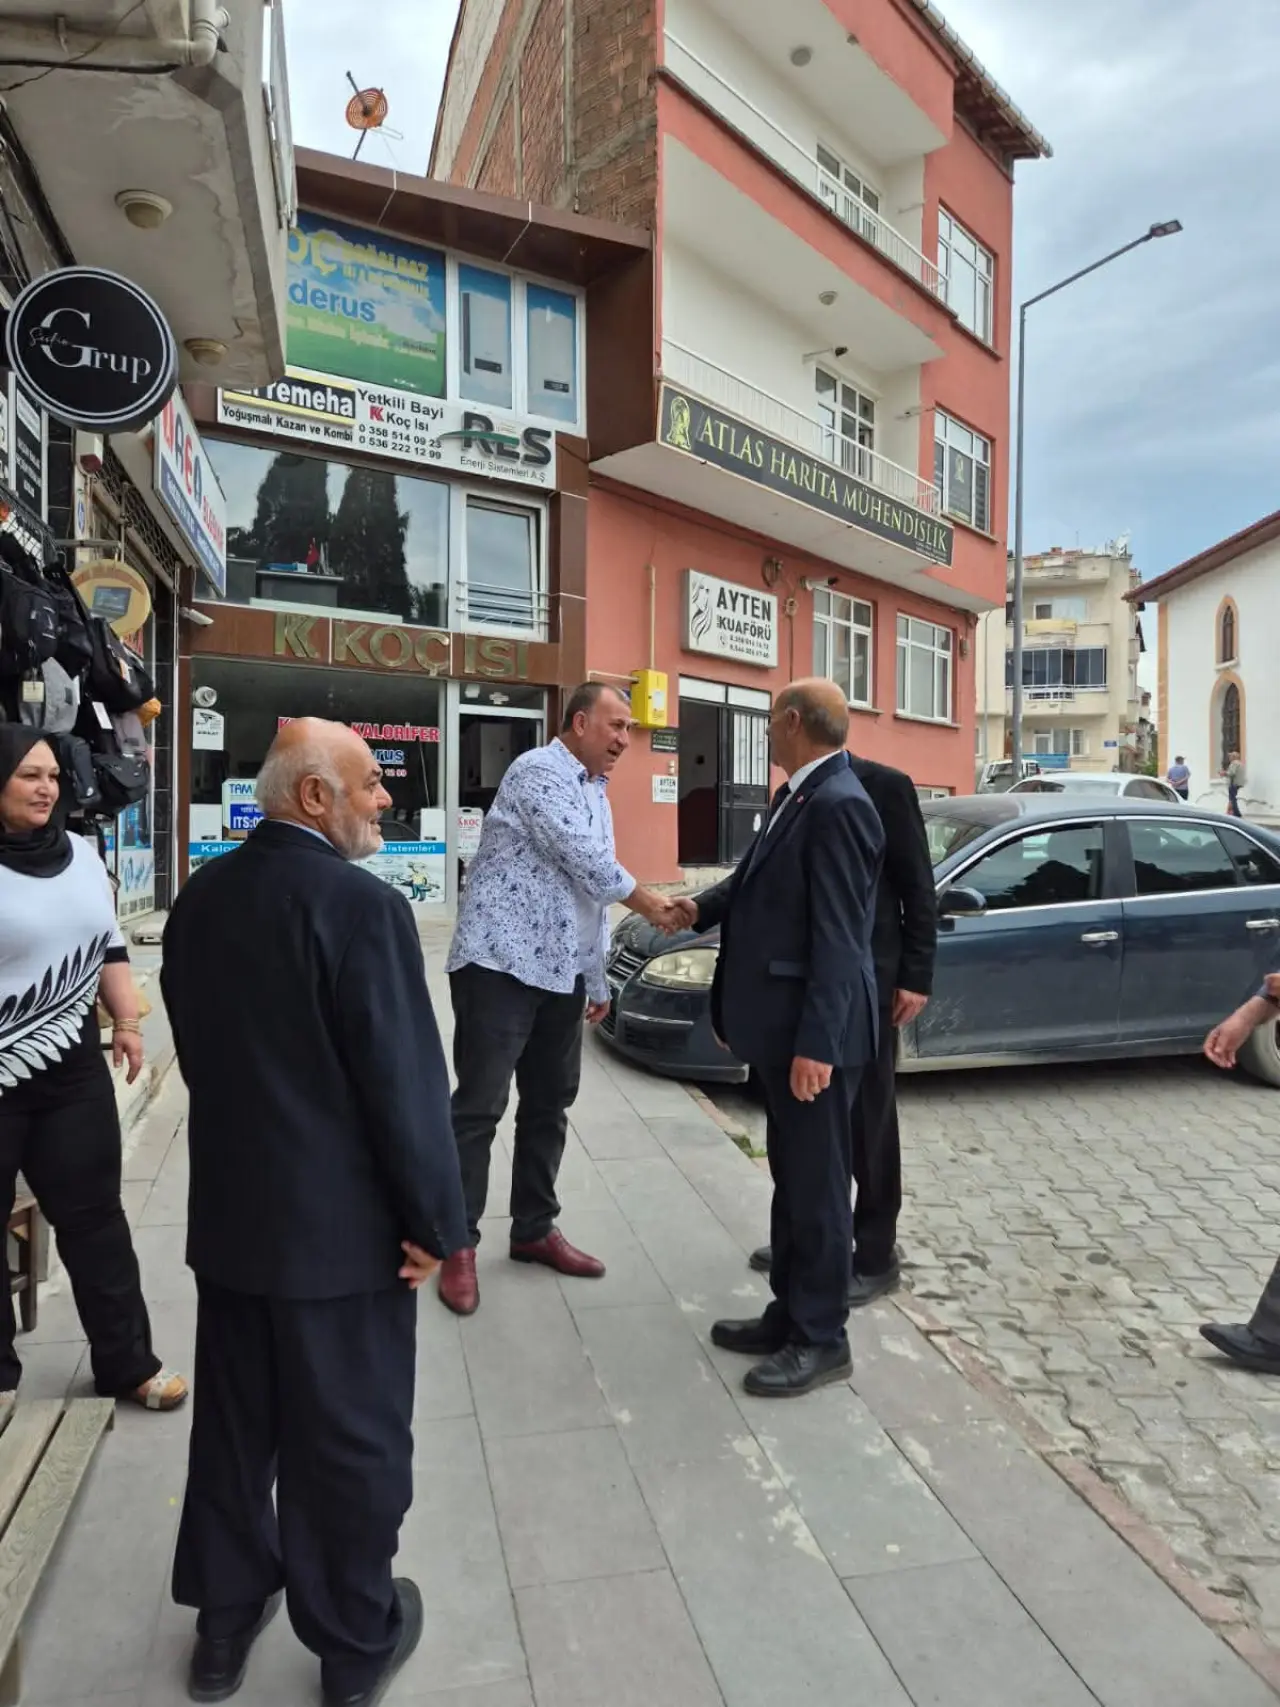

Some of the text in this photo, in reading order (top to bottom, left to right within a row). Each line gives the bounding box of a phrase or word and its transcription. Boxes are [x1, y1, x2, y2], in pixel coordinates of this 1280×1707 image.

[287, 229, 337, 275] OÇ
[289, 279, 375, 322] derus
[40, 307, 151, 384] Grup
[358, 388, 443, 420] Yetkili Bayi
[222, 405, 353, 442] Yoğuşmalı Kazan ve Kombi
[387, 412, 411, 430] Koç
[359, 424, 366, 432] 0
[369, 426, 388, 437] 358
[392, 431, 410, 442] 514
[414, 435, 426, 446] 09
[359, 435, 366, 444] 0
[369, 437, 388, 448] 536
[392, 442, 410, 453] 222
[415, 447, 426, 456] 12
[461, 456, 486, 470] Enerji
[699, 416, 947, 552] ATLAS HARİTA MÜHENDİSLİK
[717, 587, 771, 622] AYTEN
[719, 615, 771, 641] KUAFÖRÜ
[334, 621, 451, 677] KOÇ
[351, 721, 440, 743] KALORİFER
[371, 749, 405, 763] rus
[229, 783, 253, 794] TAM
[201, 844, 240, 853] Kalo
